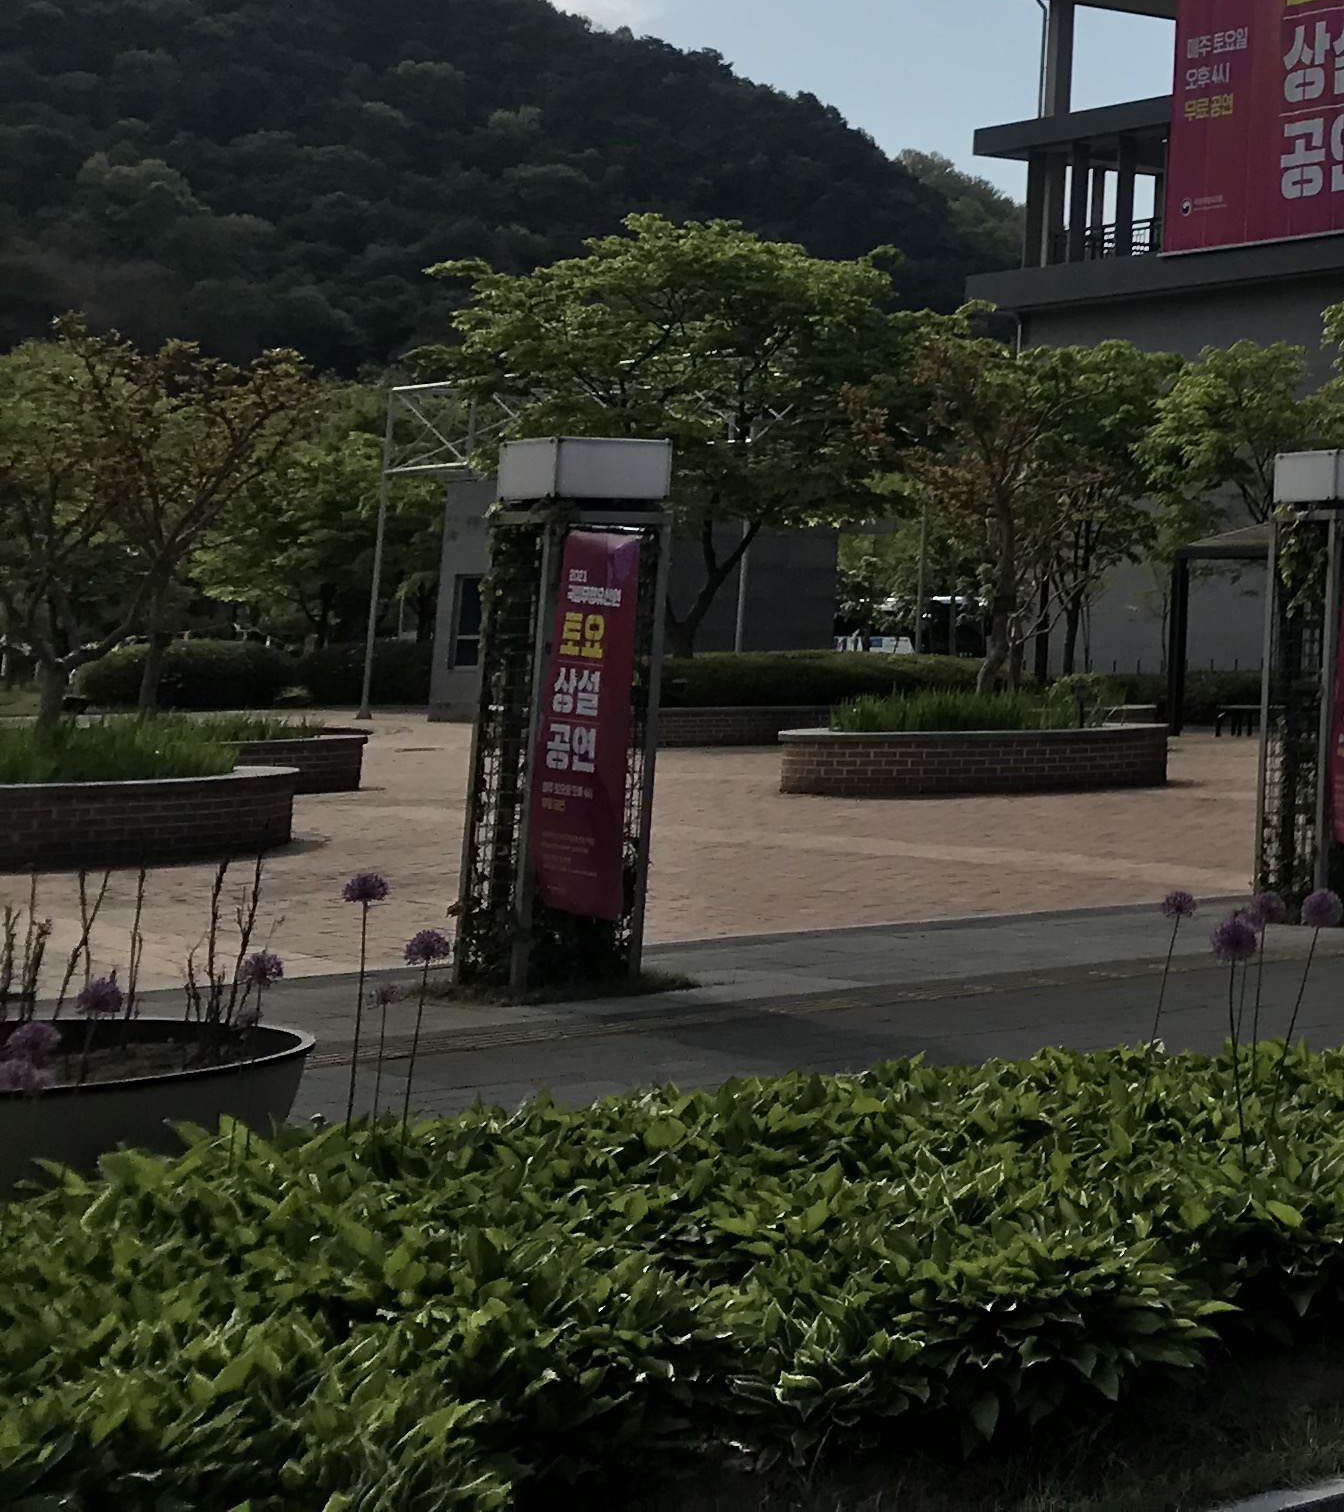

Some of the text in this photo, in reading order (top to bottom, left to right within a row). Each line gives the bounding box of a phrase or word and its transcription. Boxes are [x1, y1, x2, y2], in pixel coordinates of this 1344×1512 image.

[1213, 27, 1248, 54] 토요일
[1185, 66, 1210, 90] 오후
[1184, 92, 1234, 122] 무료 공연
[569, 568, 588, 582] 2021
[567, 584, 622, 609] 국립무형유산원
[559, 610, 606, 660] 토요
[552, 666, 601, 718] 상설
[546, 723, 597, 774] 공연
